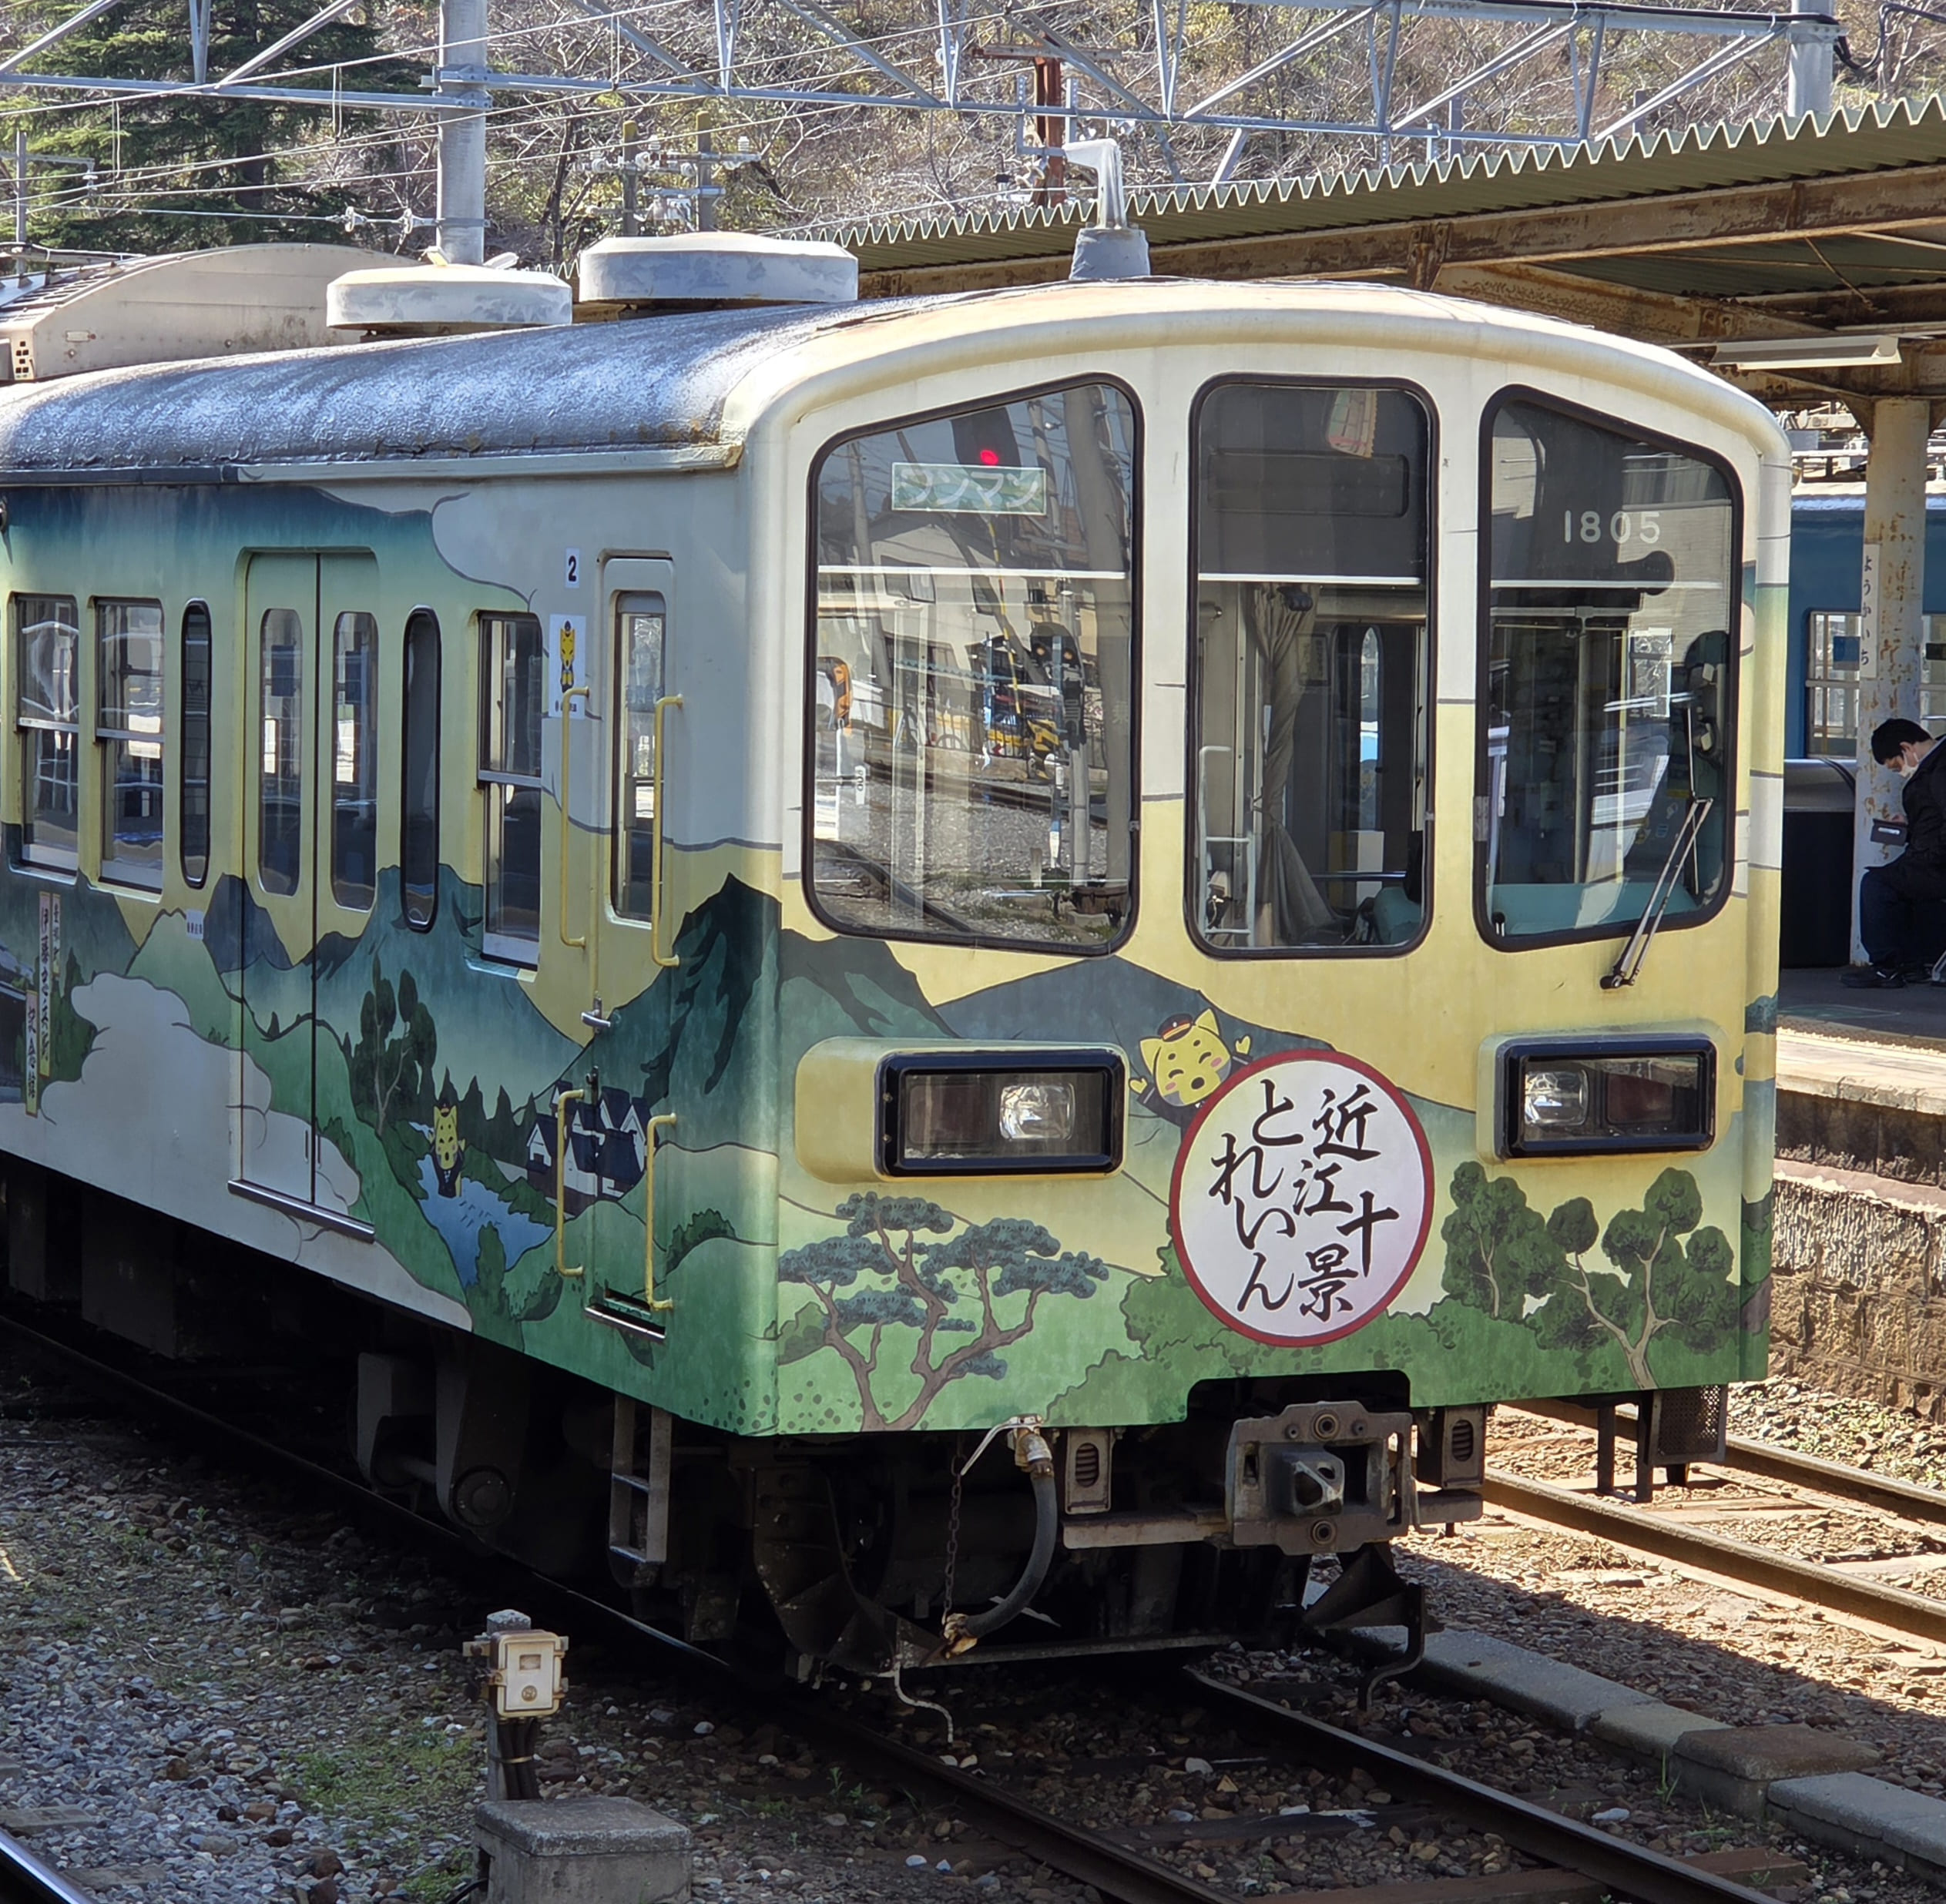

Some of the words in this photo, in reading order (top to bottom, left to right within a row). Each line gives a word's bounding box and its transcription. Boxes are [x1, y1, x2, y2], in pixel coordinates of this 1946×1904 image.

[901, 468, 1039, 508] ワンマン
[1565, 510, 1660, 544] 1805
[569, 555, 577, 582] 2
[1860, 555, 1874, 666] ようかいち
[1208, 1078, 1303, 1312] とれいん
[1293, 1083, 1400, 1322] 近江十景
